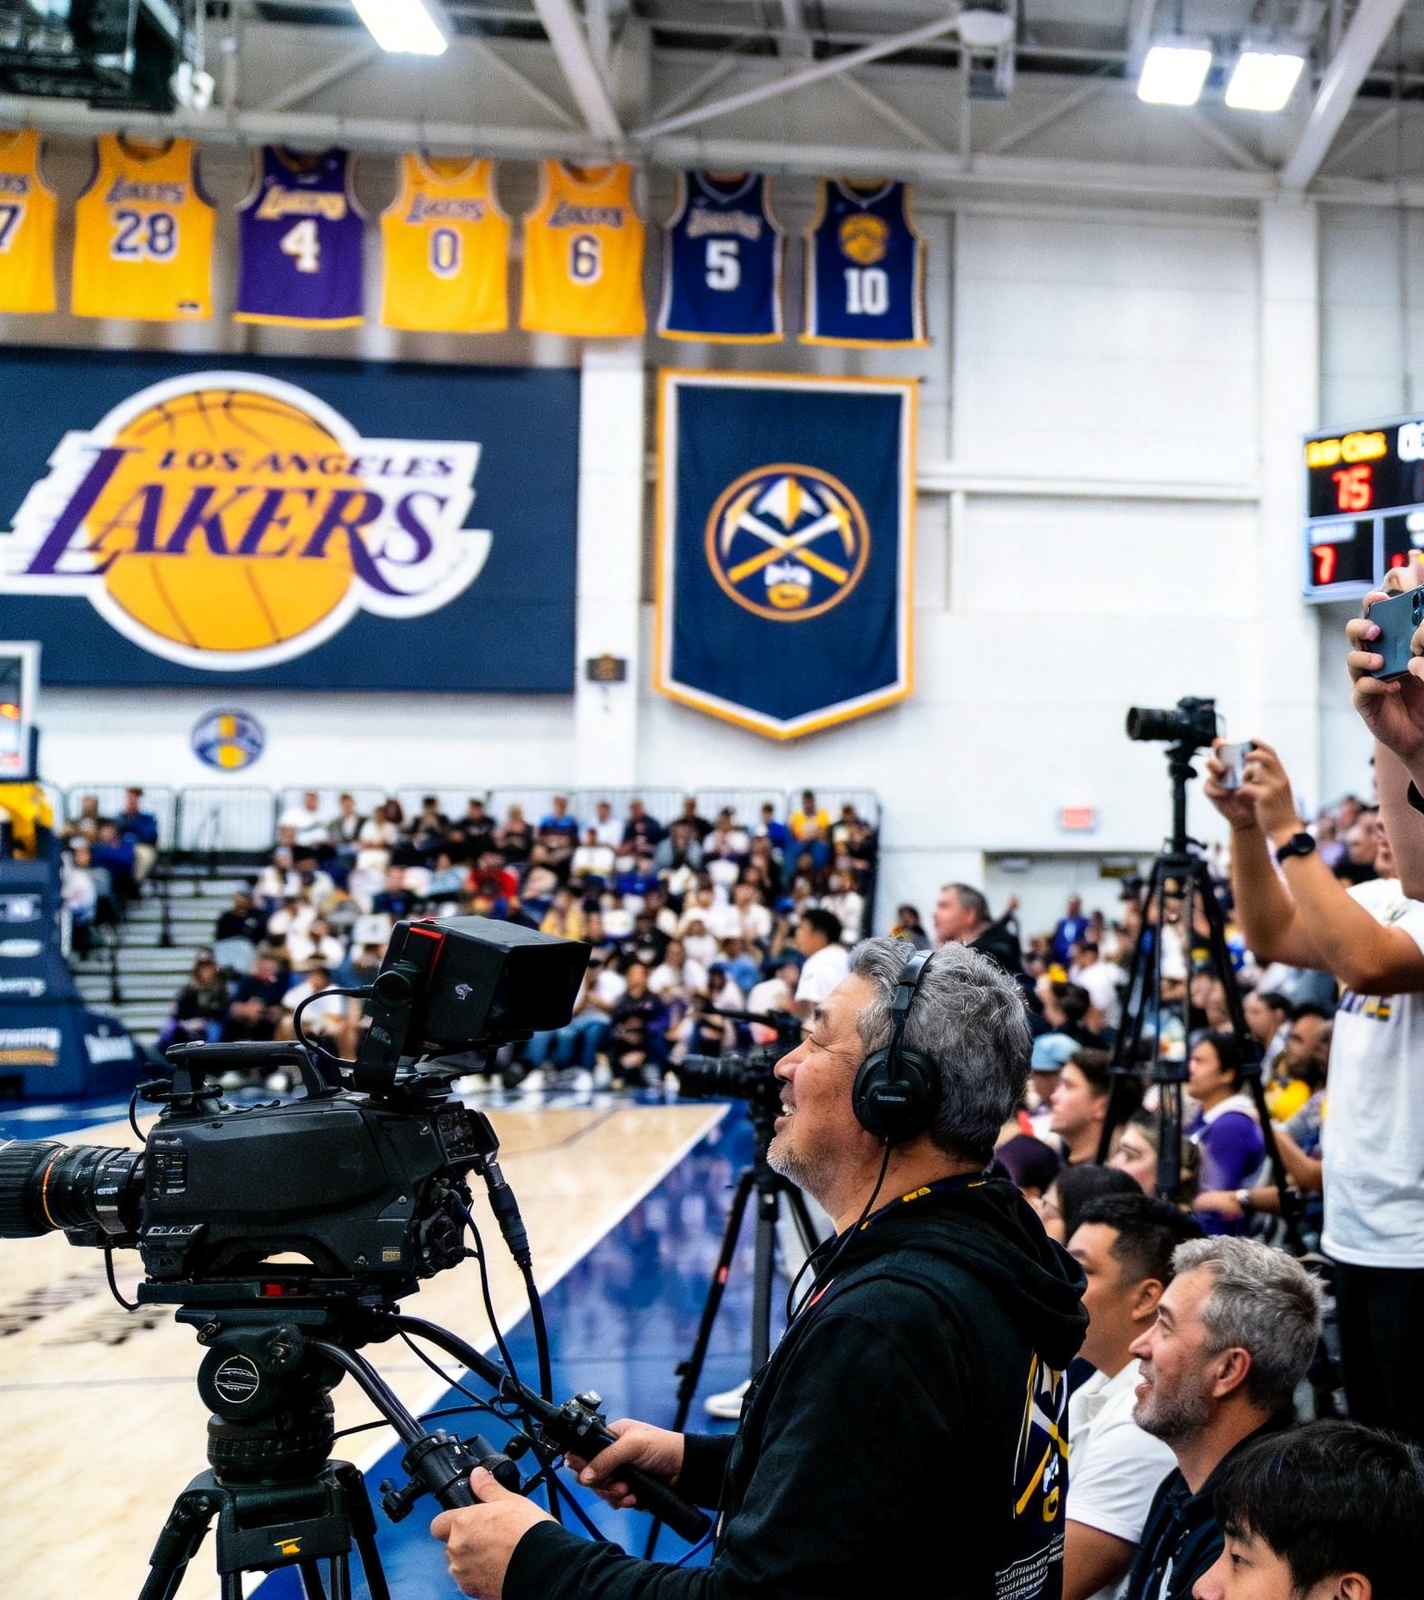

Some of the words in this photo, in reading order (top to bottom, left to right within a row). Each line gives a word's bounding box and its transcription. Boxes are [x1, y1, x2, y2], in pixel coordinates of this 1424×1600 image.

[108, 207, 181, 264] 28
[279, 218, 322, 275] 4
[429, 227, 463, 280] 0
[567, 231, 603, 286] 6
[705, 238, 741, 293] 5
[843, 266, 891, 316] 10
[158, 448, 241, 472] LOS
[252, 452, 455, 477] ANGELES
[22, 445, 450, 598] LAKERS
